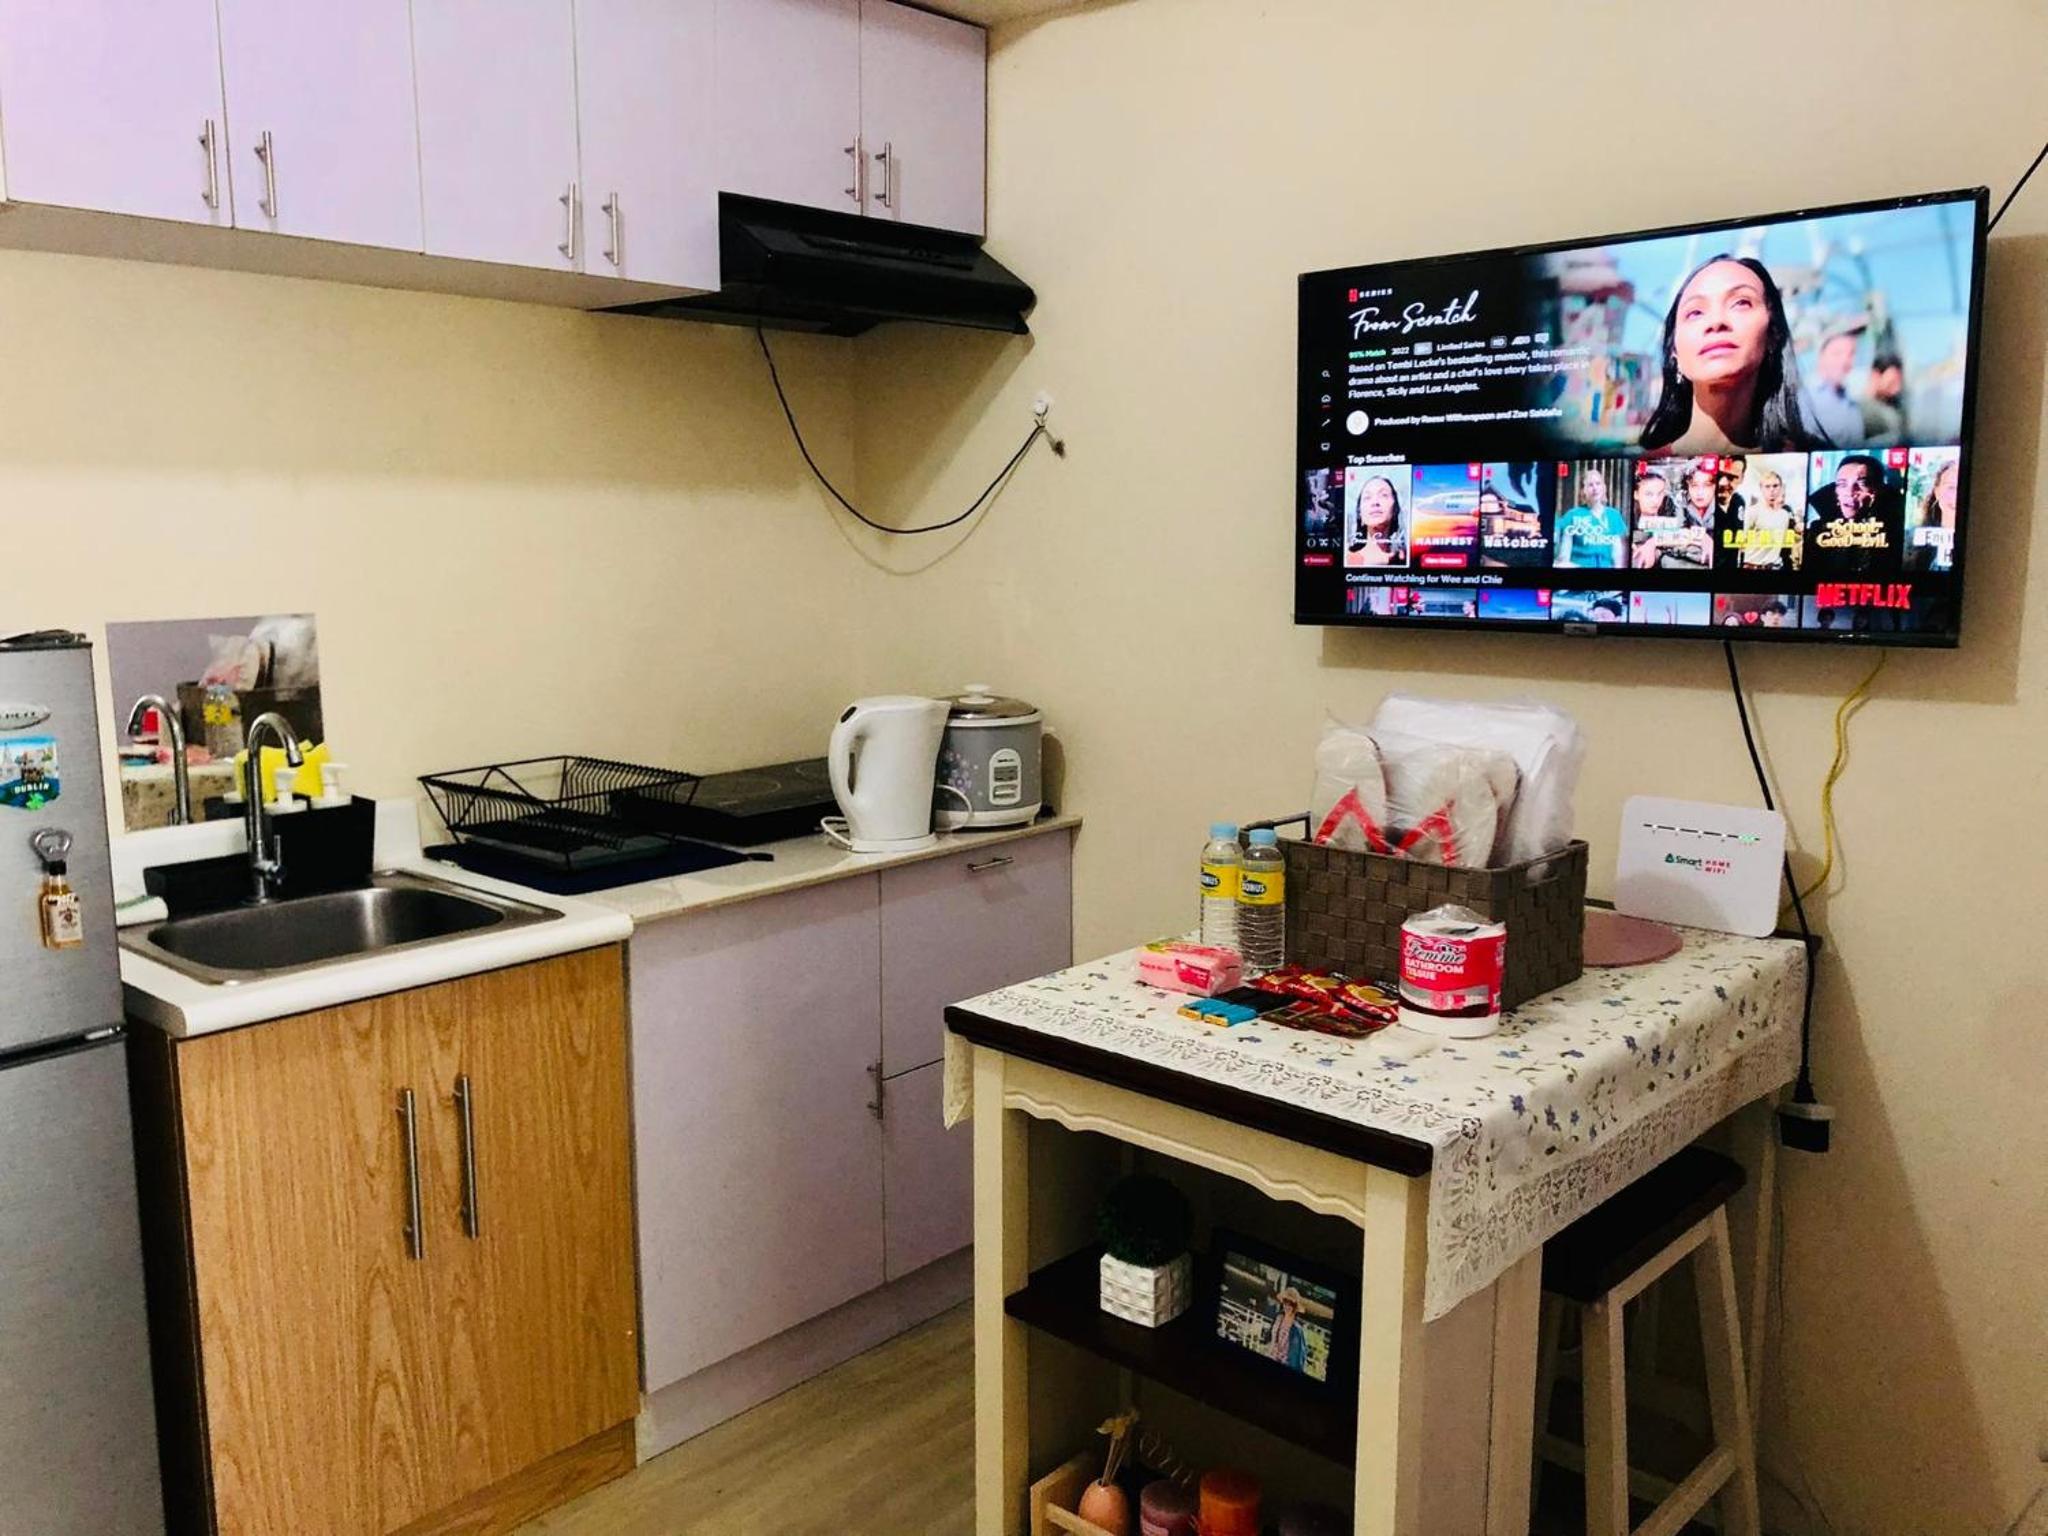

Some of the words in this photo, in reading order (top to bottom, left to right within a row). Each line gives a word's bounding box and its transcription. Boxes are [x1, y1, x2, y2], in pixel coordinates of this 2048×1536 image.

[1349, 307, 1401, 340] From
[1402, 290, 1479, 335] Scratch
[1349, 363, 1374, 373] Based
[1375, 363, 1386, 371] on
[1349, 377, 1374, 386] drama
[1375, 374, 1398, 384] about
[1433, 370, 1449, 380] and
[1504, 365, 1527, 375] story
[1528, 363, 1553, 373] takes
[1409, 385, 1425, 395] and
[1426, 384, 1442, 394] Los
[1374, 416, 1409, 426] Produced
[1410, 416, 1420, 426] by
[1496, 411, 1511, 420] and
[1347, 455, 1365, 465] Top
[1366, 453, 1406, 464] Searches
[1415, 536, 1474, 546] MANIFEST
[1345, 573, 1383, 583] Continue
[1384, 574, 1426, 585] Watching
[1427, 574, 1439, 583] for
[1440, 575, 1462, 583] Wee
[1462, 575, 1480, 583] and
[1815, 583, 1912, 609] NETFLIX
[14, 782, 50, 794] DUBLIN
[1405, 957, 1464, 974] BATHROOM
